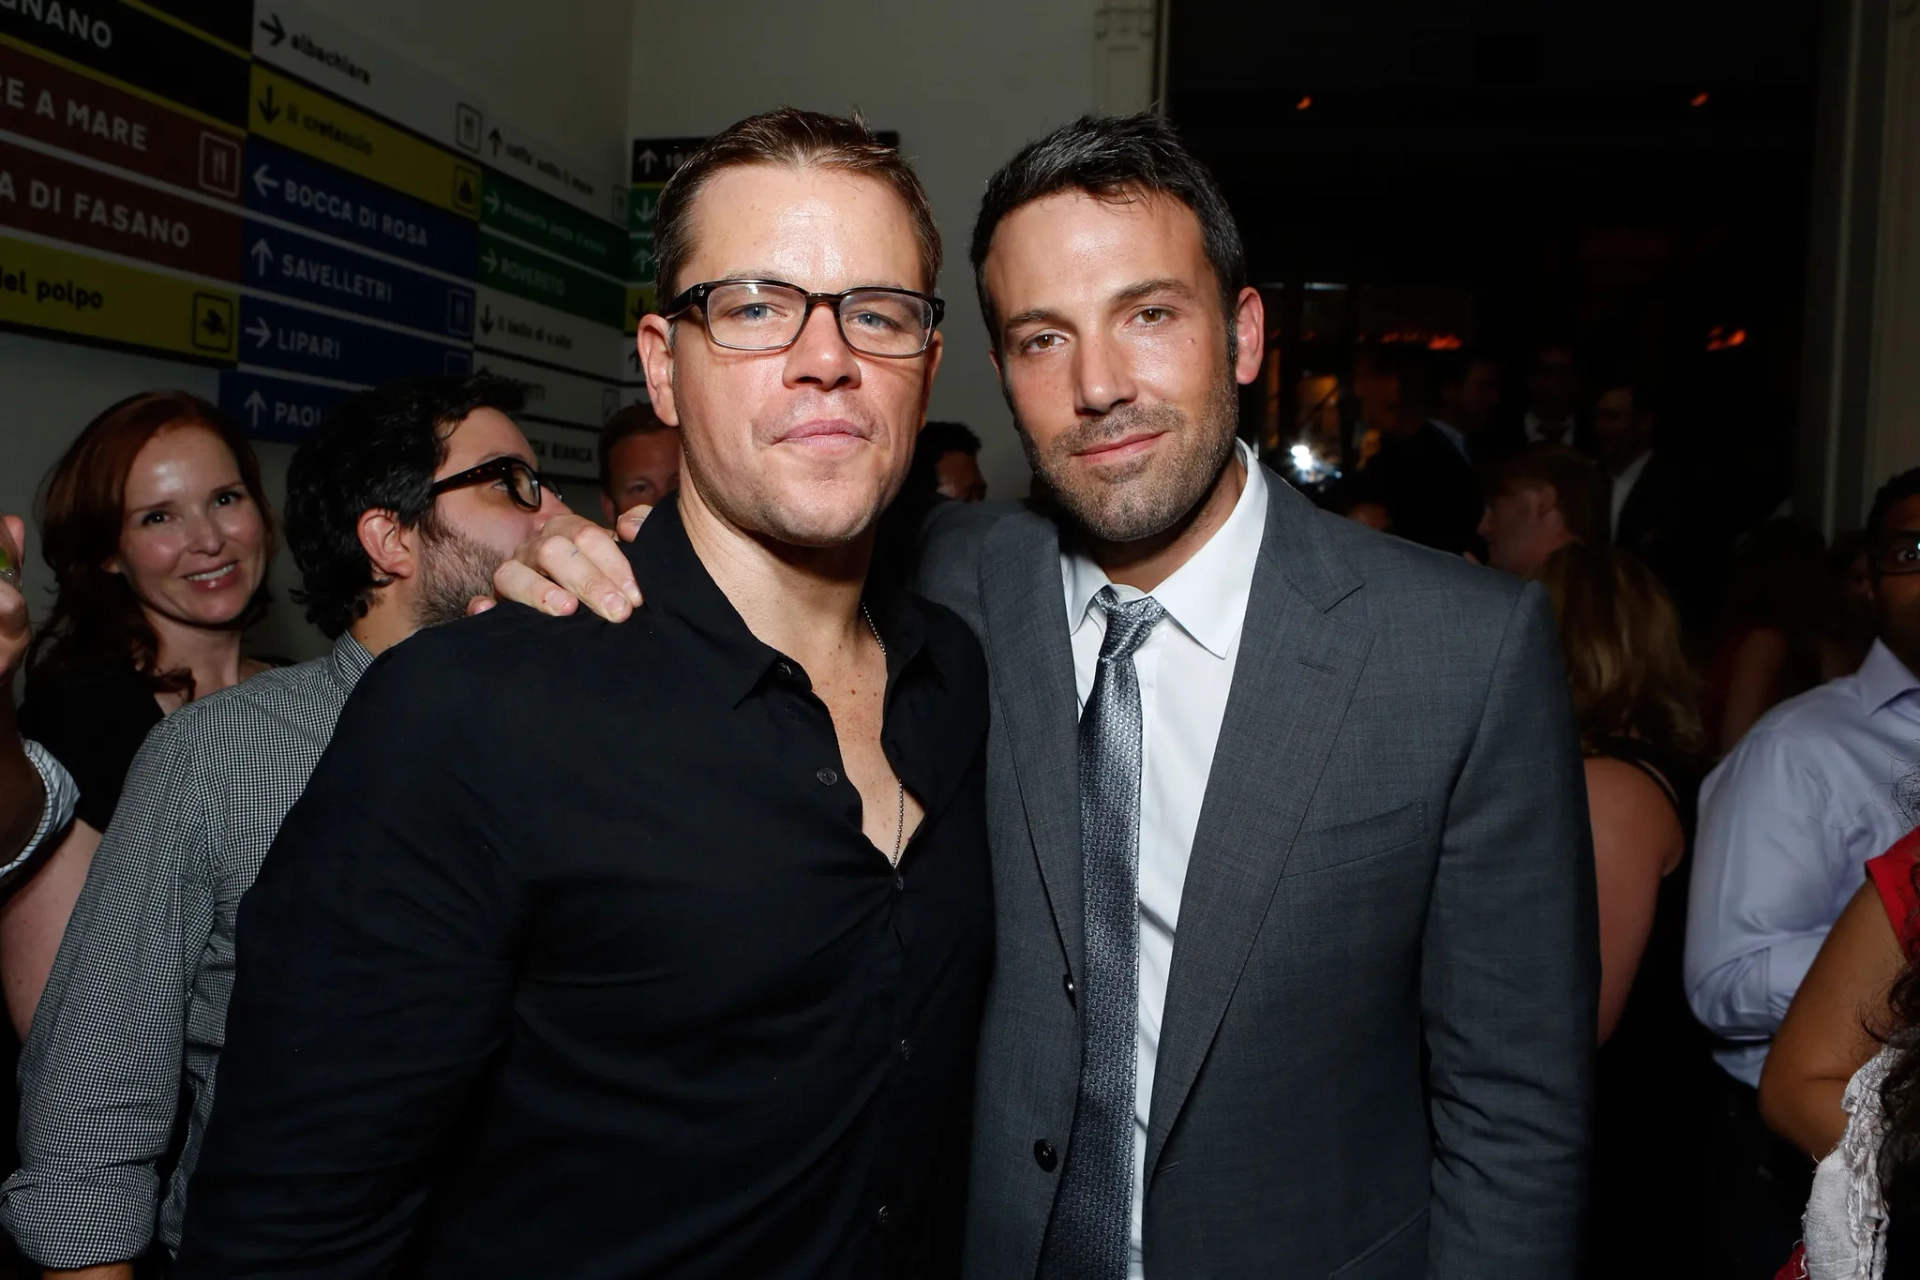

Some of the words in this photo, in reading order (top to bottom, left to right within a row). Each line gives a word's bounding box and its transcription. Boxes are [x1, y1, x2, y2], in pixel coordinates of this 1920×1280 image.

[36, 89, 56, 120] A
[66, 98, 148, 152] MARE
[29, 179, 61, 215] DI
[73, 192, 190, 249] FASANO
[284, 178, 353, 223] BOCCA
[359, 205, 377, 231] DI
[382, 213, 428, 248] ROSA
[36, 279, 103, 311] polpo
[281, 253, 392, 304] SAVELLETRI
[500, 257, 566, 296] ROVERETO
[277, 327, 340, 361] LIPARI
[552, 442, 593, 464] BIANCA
